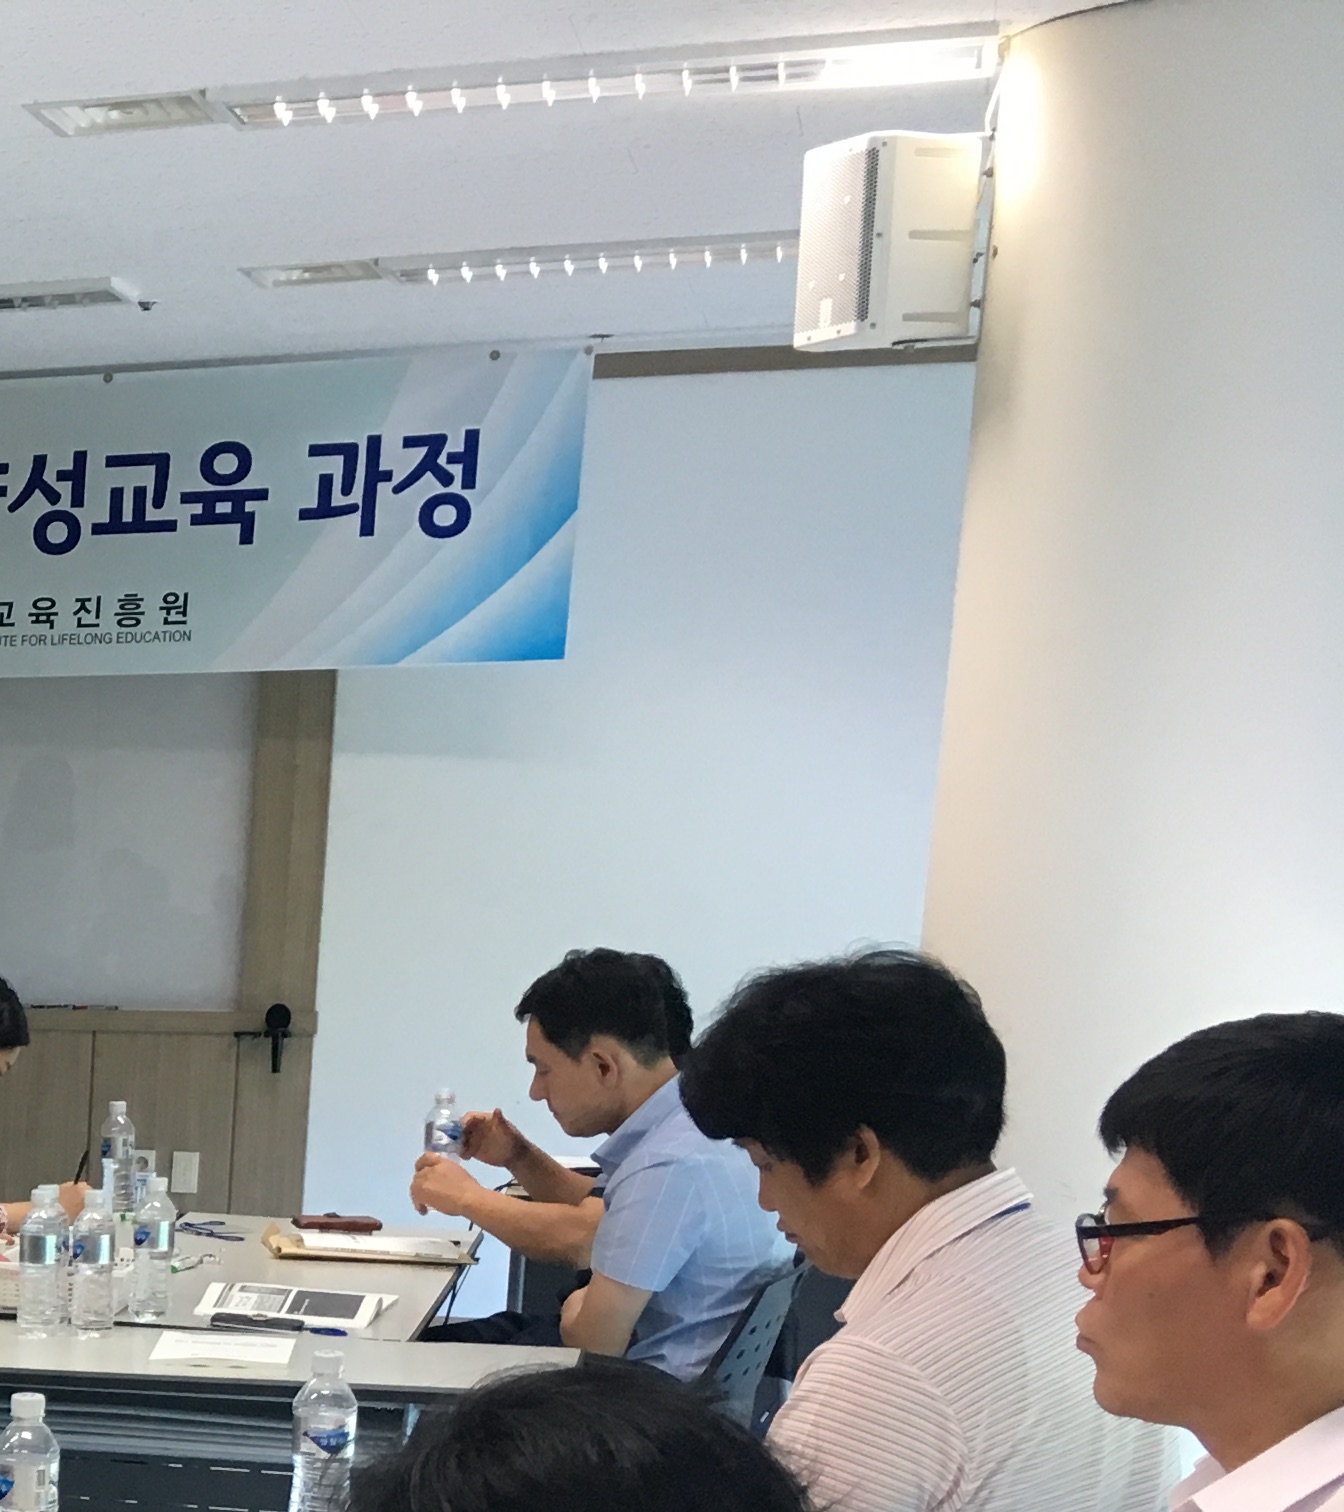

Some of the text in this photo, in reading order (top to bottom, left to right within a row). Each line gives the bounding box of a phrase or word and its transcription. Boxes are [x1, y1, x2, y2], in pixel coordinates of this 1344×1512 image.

[298, 428, 480, 539] 과정
[20, 633, 47, 646] FOR
[50, 632, 113, 645] LIFELONG
[115, 629, 193, 644] EDUCATION
